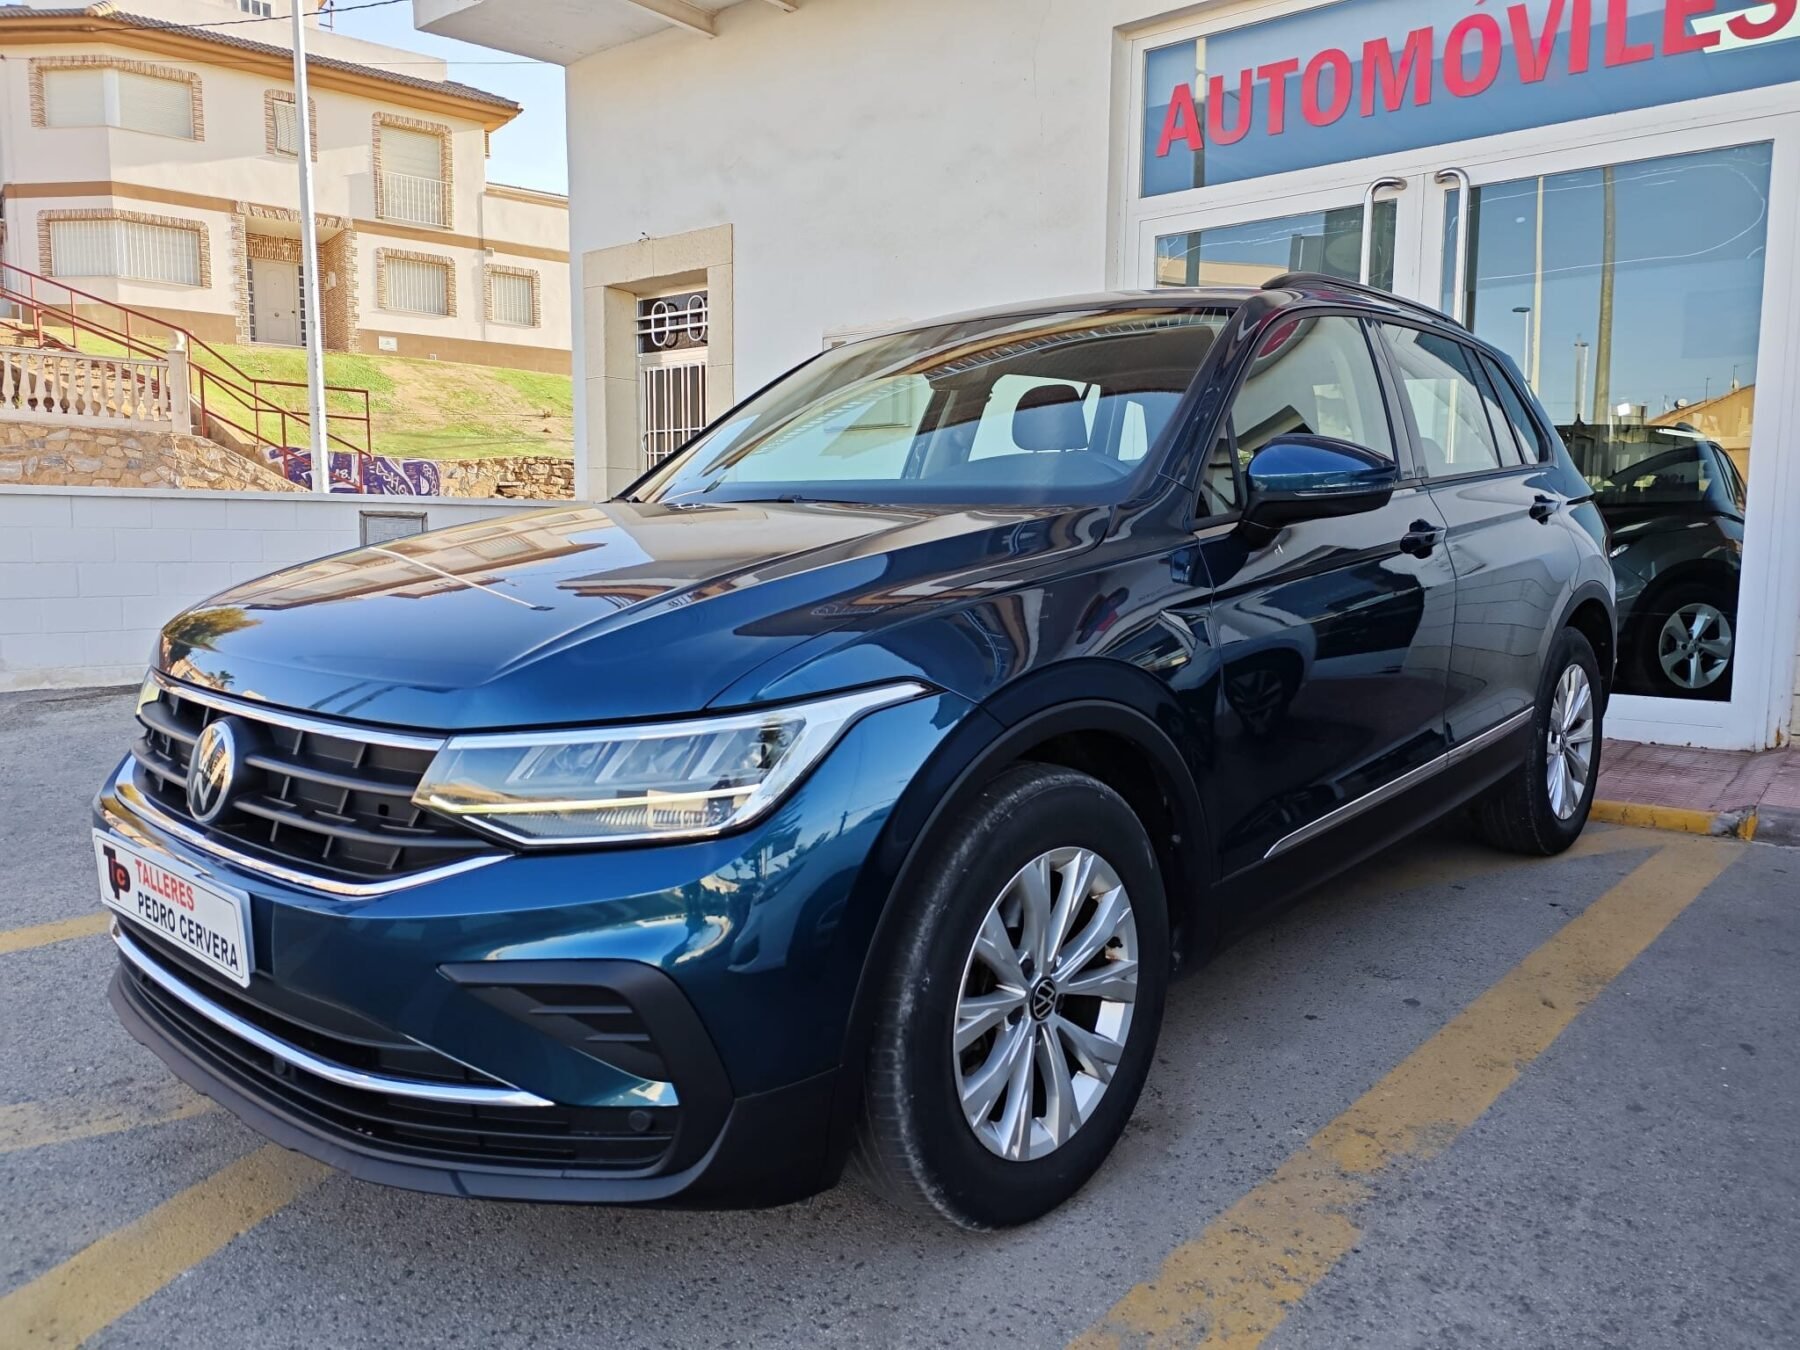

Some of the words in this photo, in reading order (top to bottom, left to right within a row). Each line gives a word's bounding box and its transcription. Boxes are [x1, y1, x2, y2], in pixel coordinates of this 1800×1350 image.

[135, 859, 195, 912] TALLERES
[137, 891, 176, 933] PEDRO
[179, 914, 239, 971] CERVERA
